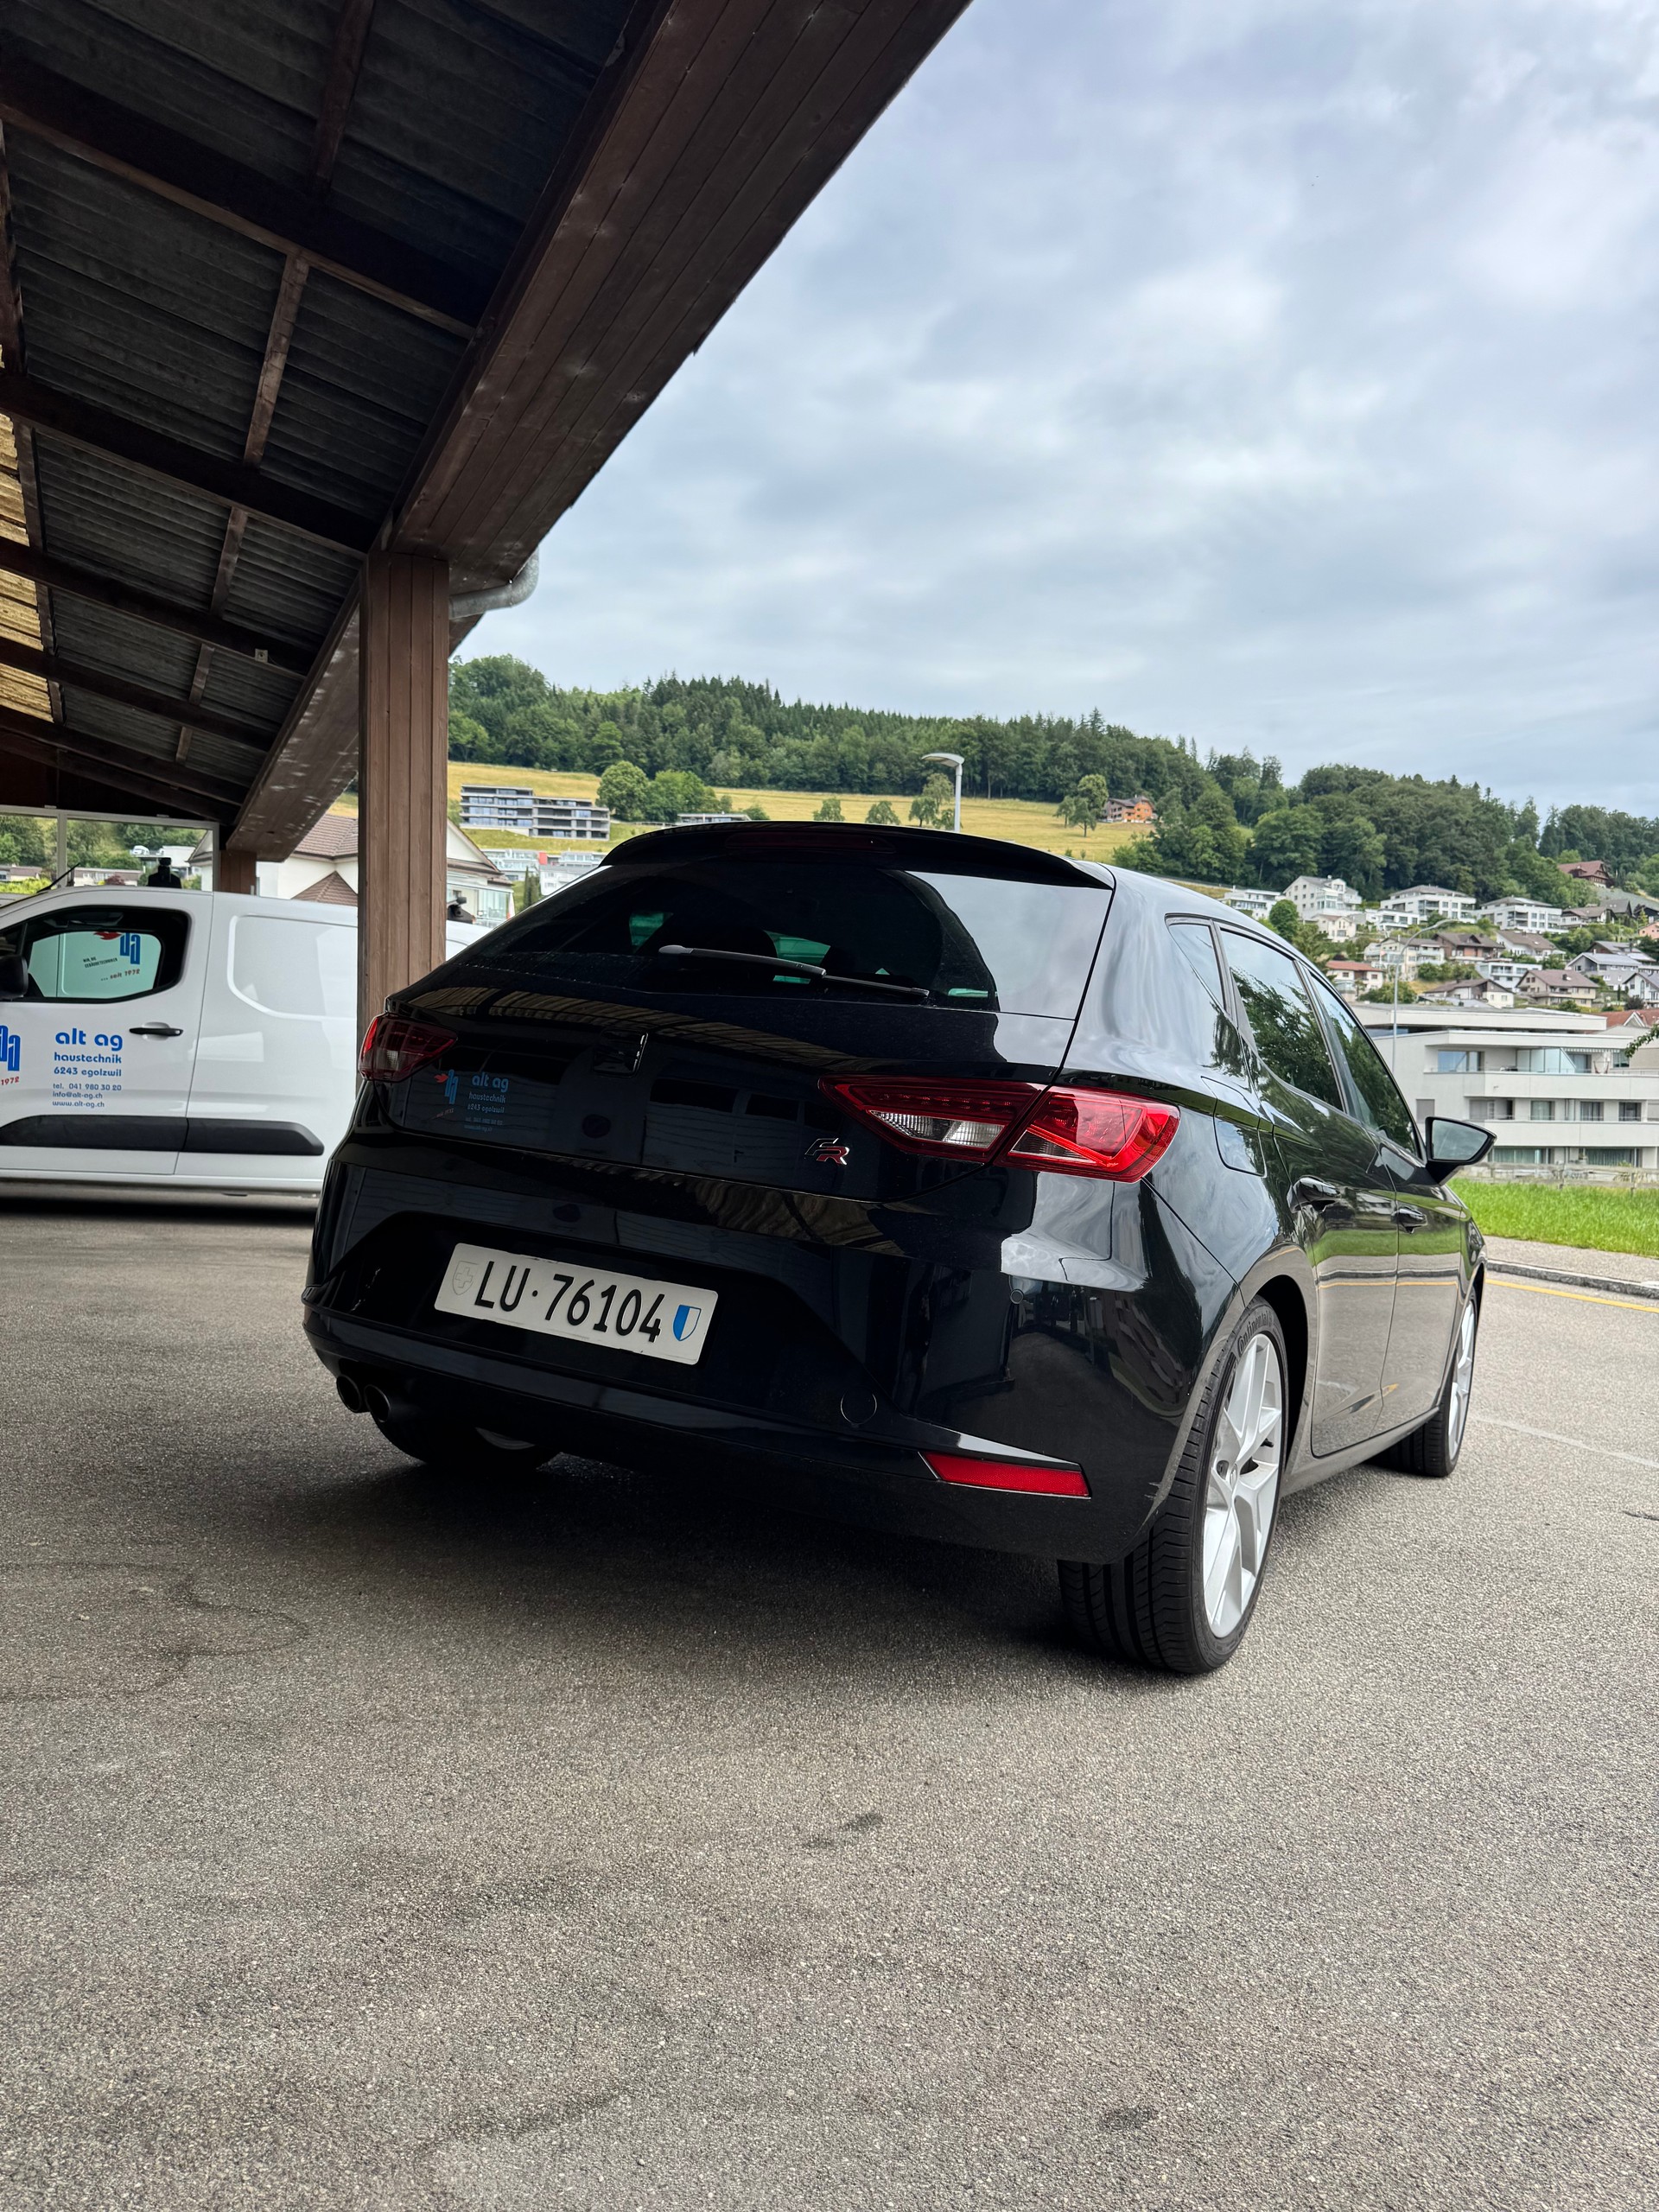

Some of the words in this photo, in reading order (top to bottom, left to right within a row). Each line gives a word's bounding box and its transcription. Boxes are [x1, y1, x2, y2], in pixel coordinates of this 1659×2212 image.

[55, 1027, 86, 1045] alt
[94, 1033, 123, 1052] ag
[54, 1052, 122, 1064] haustechnik
[54, 1066, 78, 1075] 6243
[81, 1069, 122, 1077] egolzwil
[1, 1076, 20, 1086] 1972
[472, 1072, 490, 1087] alt
[493, 1077, 510, 1093] ag
[52, 1091, 103, 1100] info@alt-ag.ch
[804, 1138, 850, 1166] FR
